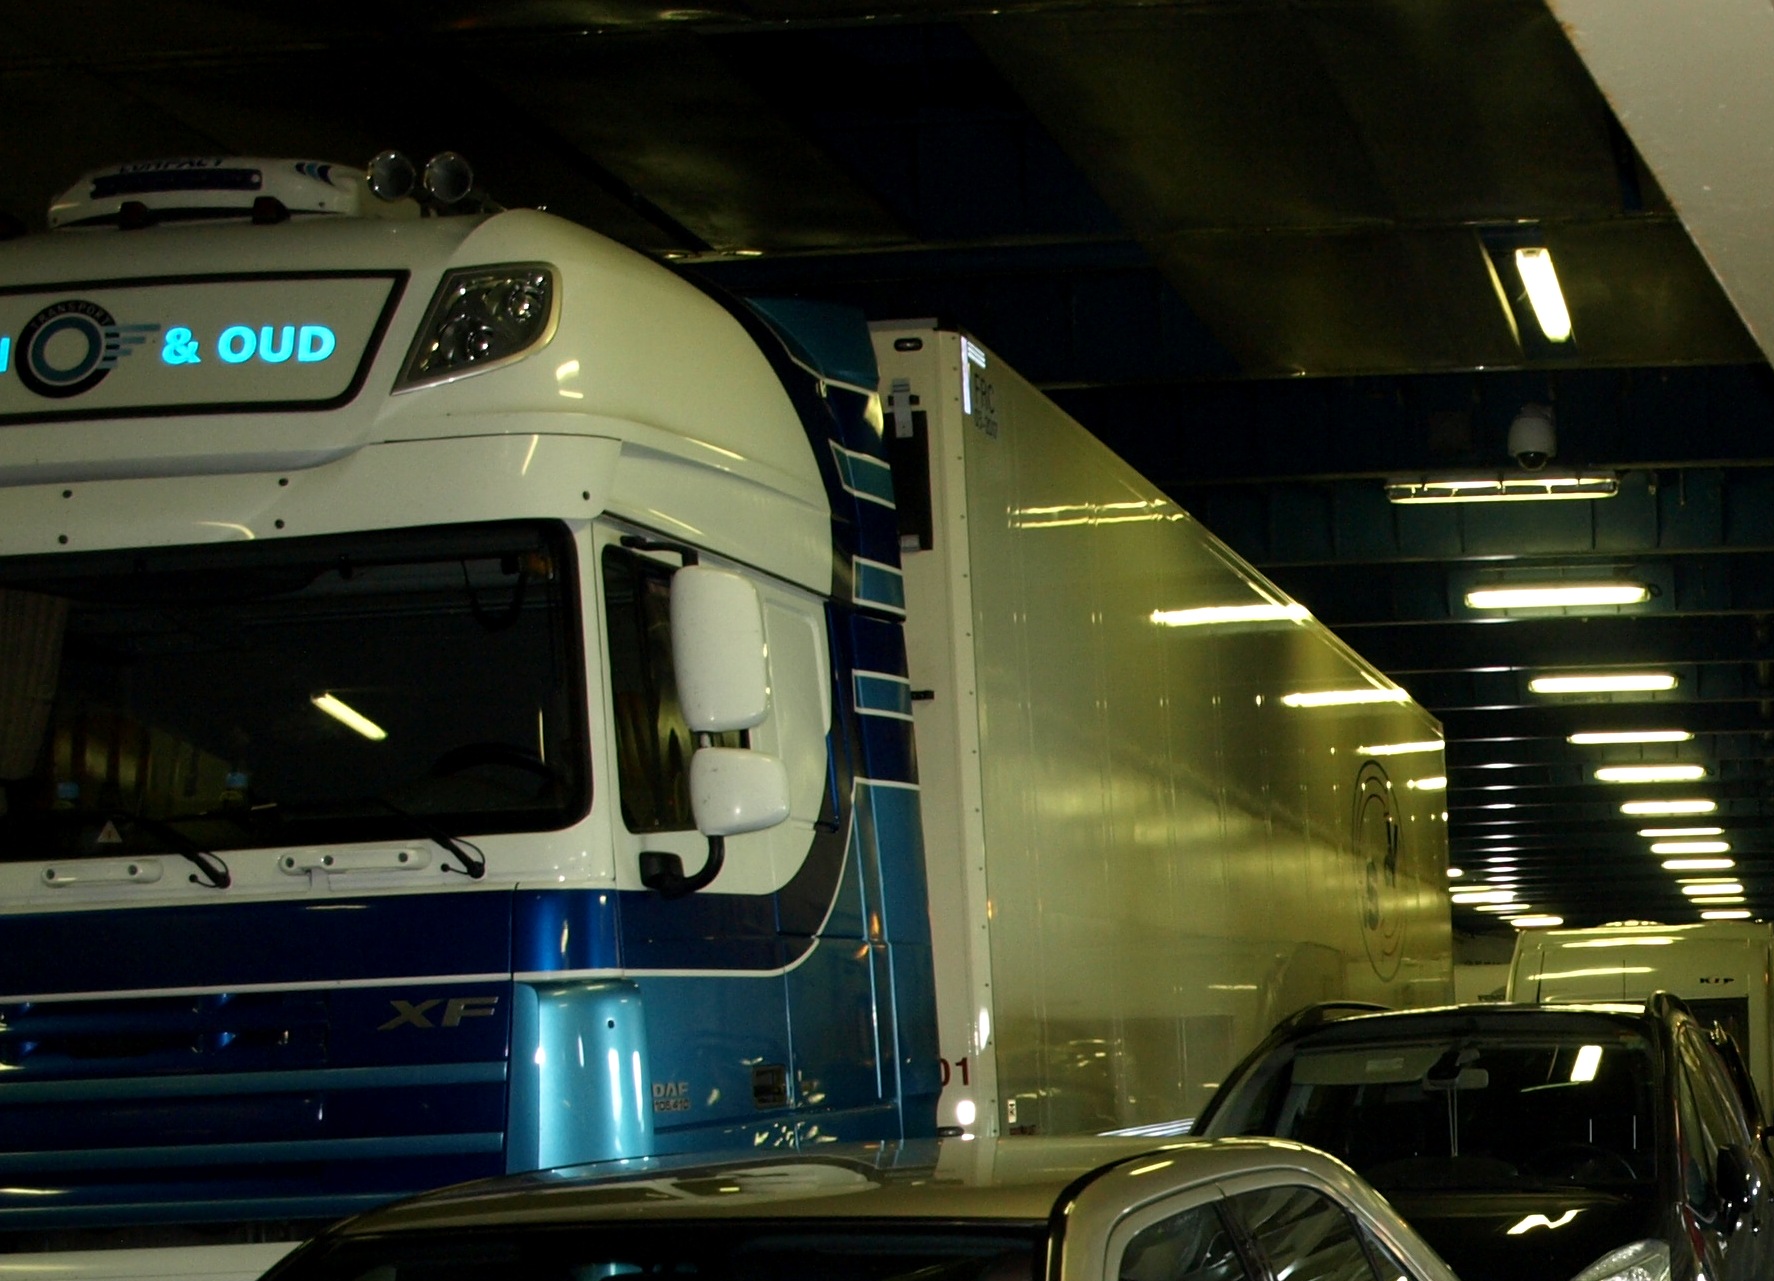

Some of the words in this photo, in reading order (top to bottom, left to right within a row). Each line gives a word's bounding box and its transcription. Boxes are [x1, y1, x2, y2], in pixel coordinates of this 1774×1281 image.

[30, 301, 110, 329] TRANSPORT
[161, 326, 201, 364] &
[217, 324, 337, 364] OUD
[377, 996, 499, 1030] XF
[653, 1082, 688, 1098] DAF
